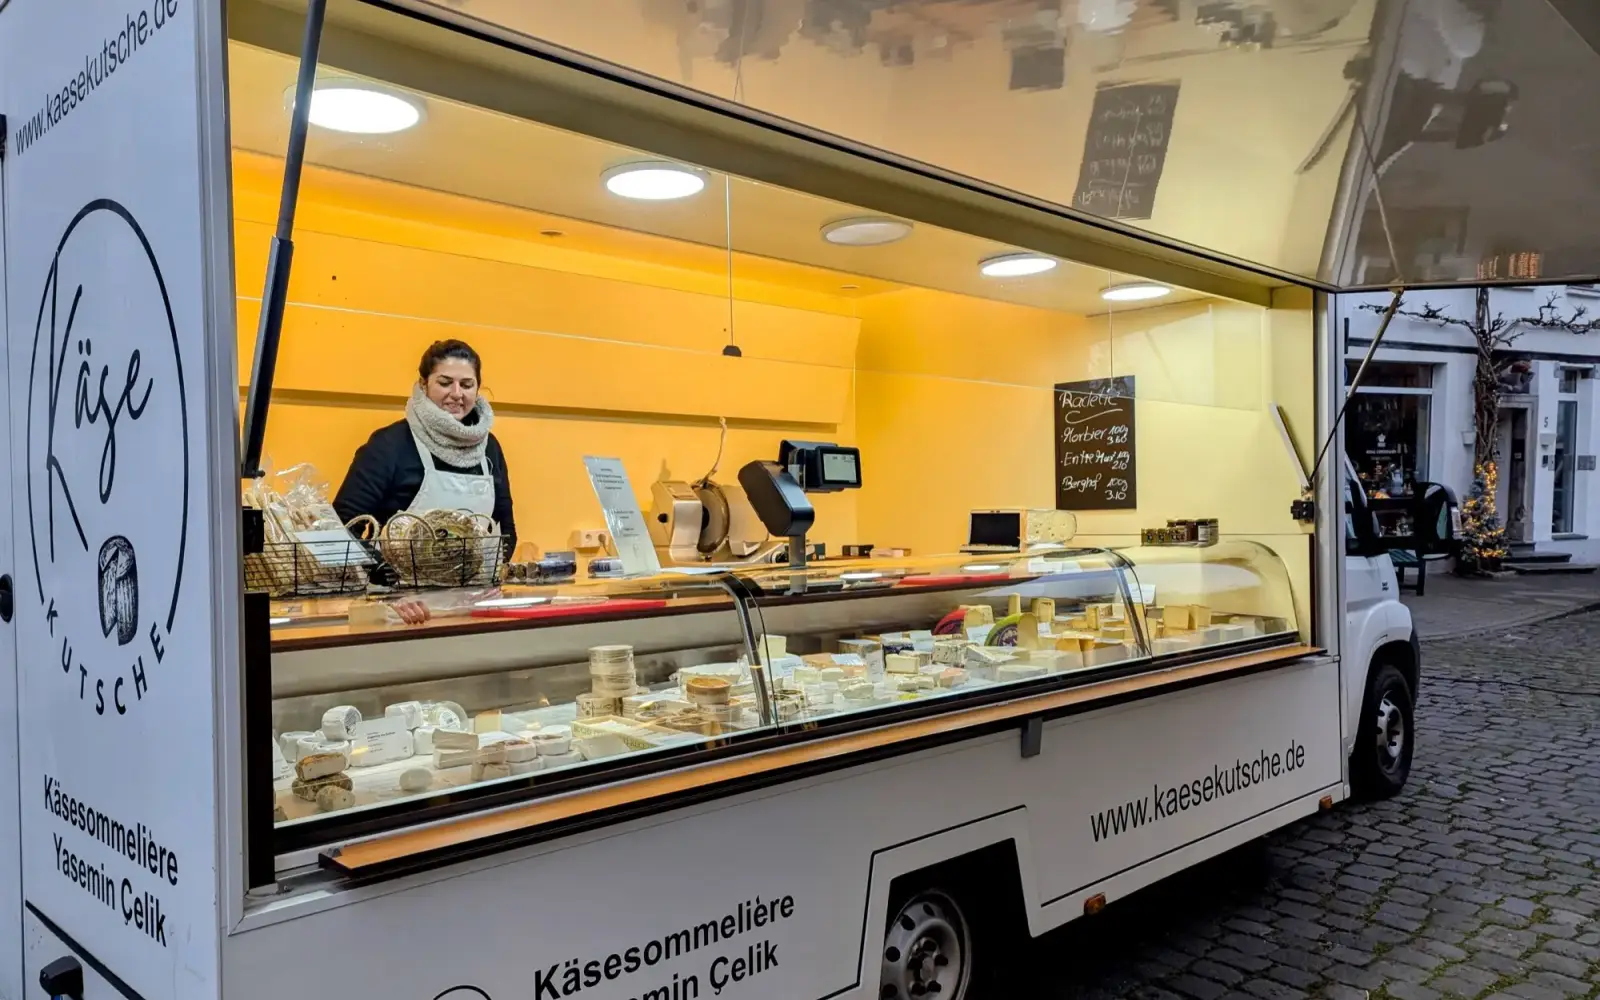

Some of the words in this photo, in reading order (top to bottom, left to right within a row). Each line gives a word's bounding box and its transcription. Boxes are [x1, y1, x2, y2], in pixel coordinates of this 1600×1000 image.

[46, 251, 153, 563] Käse
[1543, 416, 1549, 428] 5
[47, 598, 164, 715] KUTSCHE
[44, 774, 178, 886] Käsesommelière
[1090, 739, 1304, 842] www.kaesekutsche.de
[53, 832, 115, 910] Yasemin
[121, 877, 167, 947] Çelik
[535, 895, 794, 1000] Käsesommelière
[709, 939, 779, 995] Çelik
